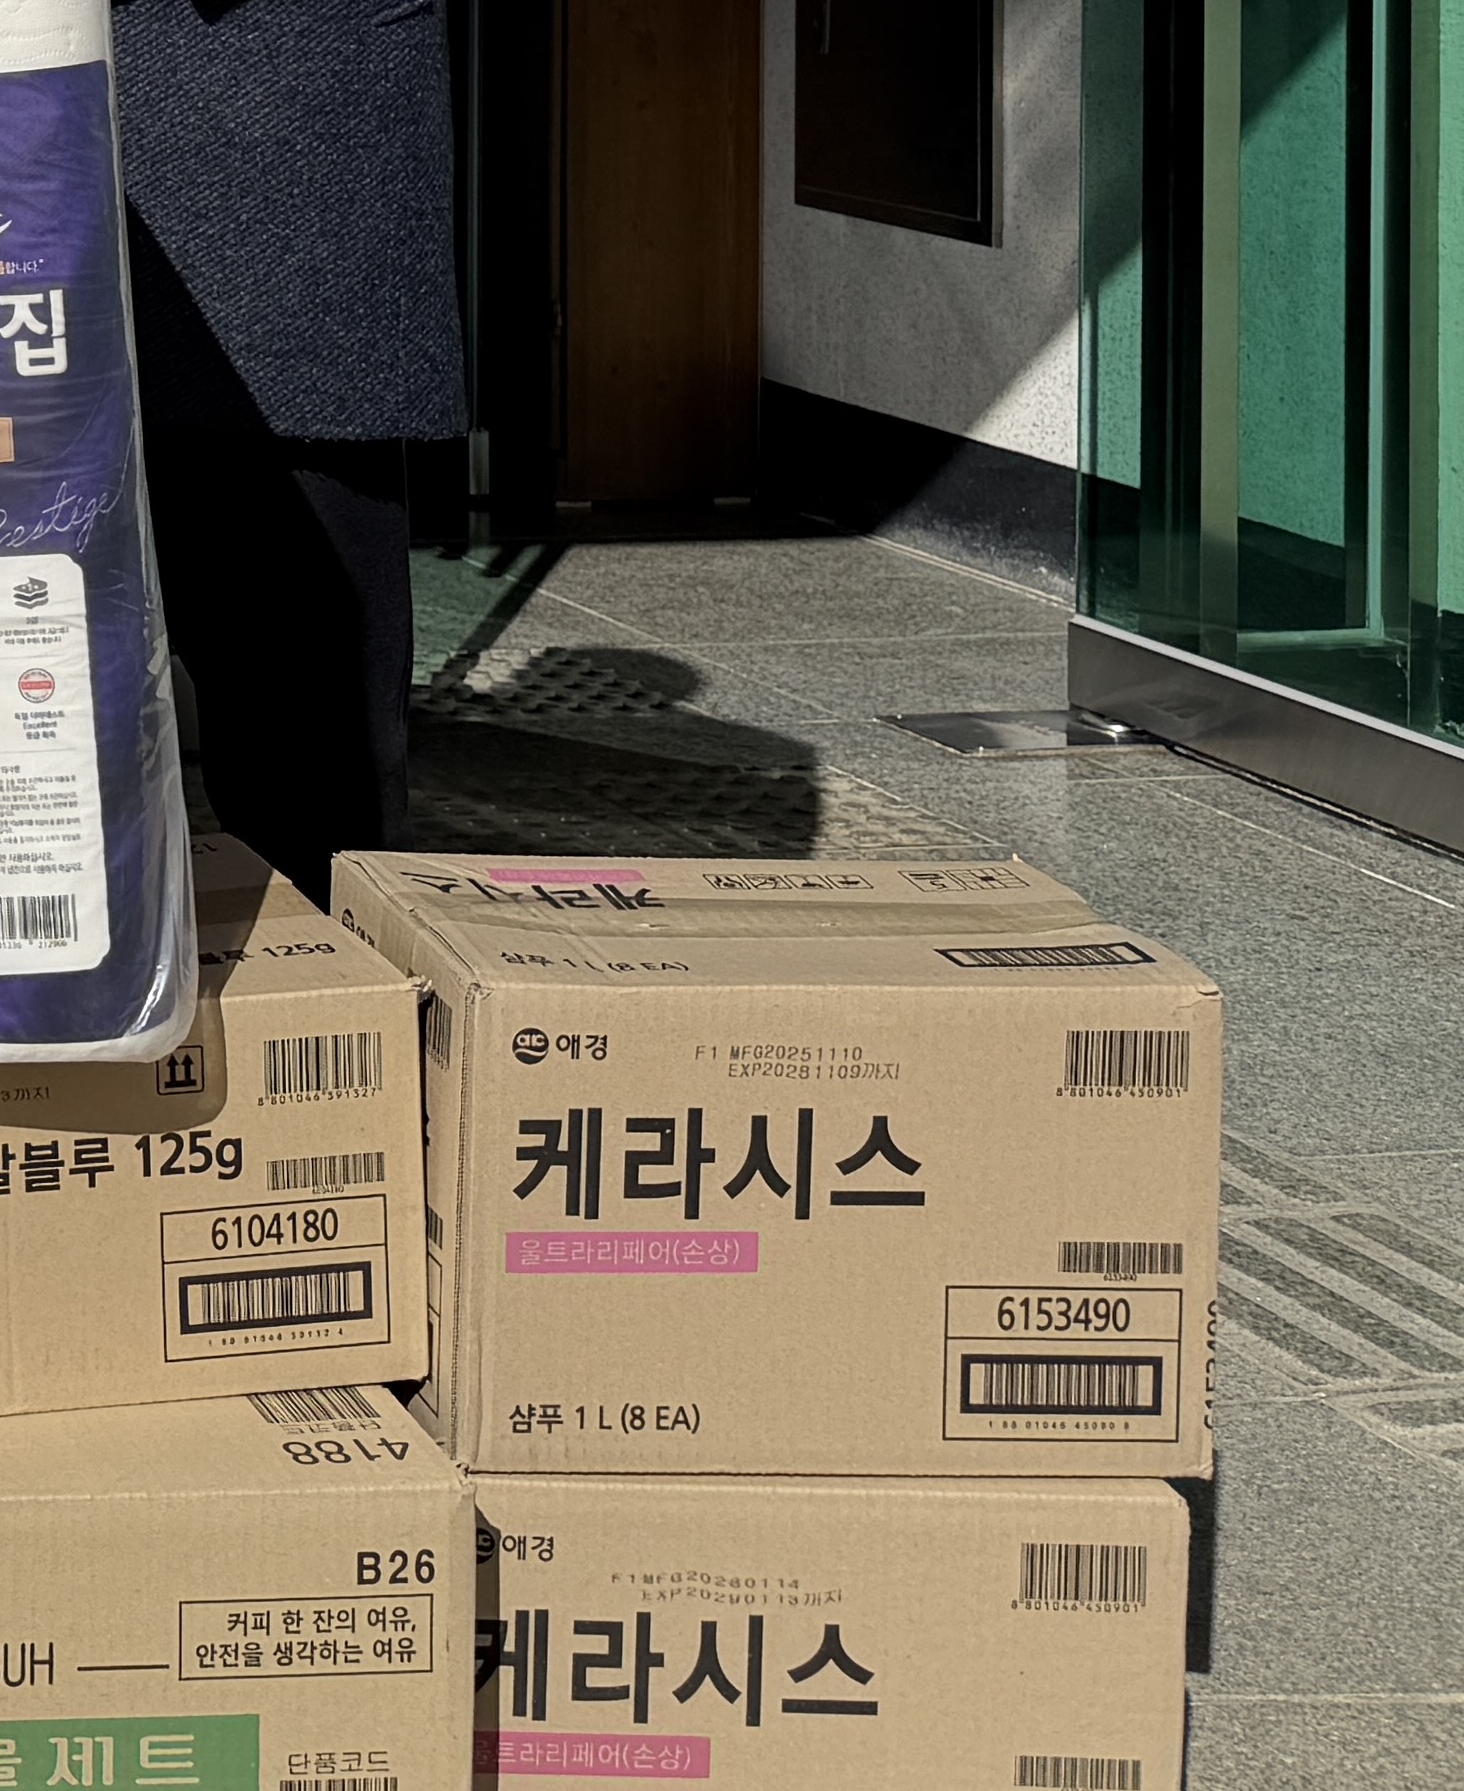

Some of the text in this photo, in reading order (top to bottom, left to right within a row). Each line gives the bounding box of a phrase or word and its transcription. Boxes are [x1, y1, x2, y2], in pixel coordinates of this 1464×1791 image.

[261, 942, 337, 958] 125g
[554, 1032, 609, 1061] 애경
[134, 1129, 244, 1181] 125g
[511, 1106, 926, 1221] 케라시스
[211, 1207, 339, 1251] 6104180
[517, 1236, 741, 1267] 울트라리페어(손상)
[996, 1295, 1132, 1334] 6153490
[501, 1534, 555, 1563] 애경
[355, 1549, 437, 1587] B26
[225, 1611, 271, 1637] 커피
[282, 1609, 304, 1636] 한
[312, 1608, 357, 1634] 잔의
[194, 1637, 418, 1670] 안전을 생각하는 여유
[474, 1607, 880, 1729] 케라시스
[287, 1750, 391, 1776] 단품코드
